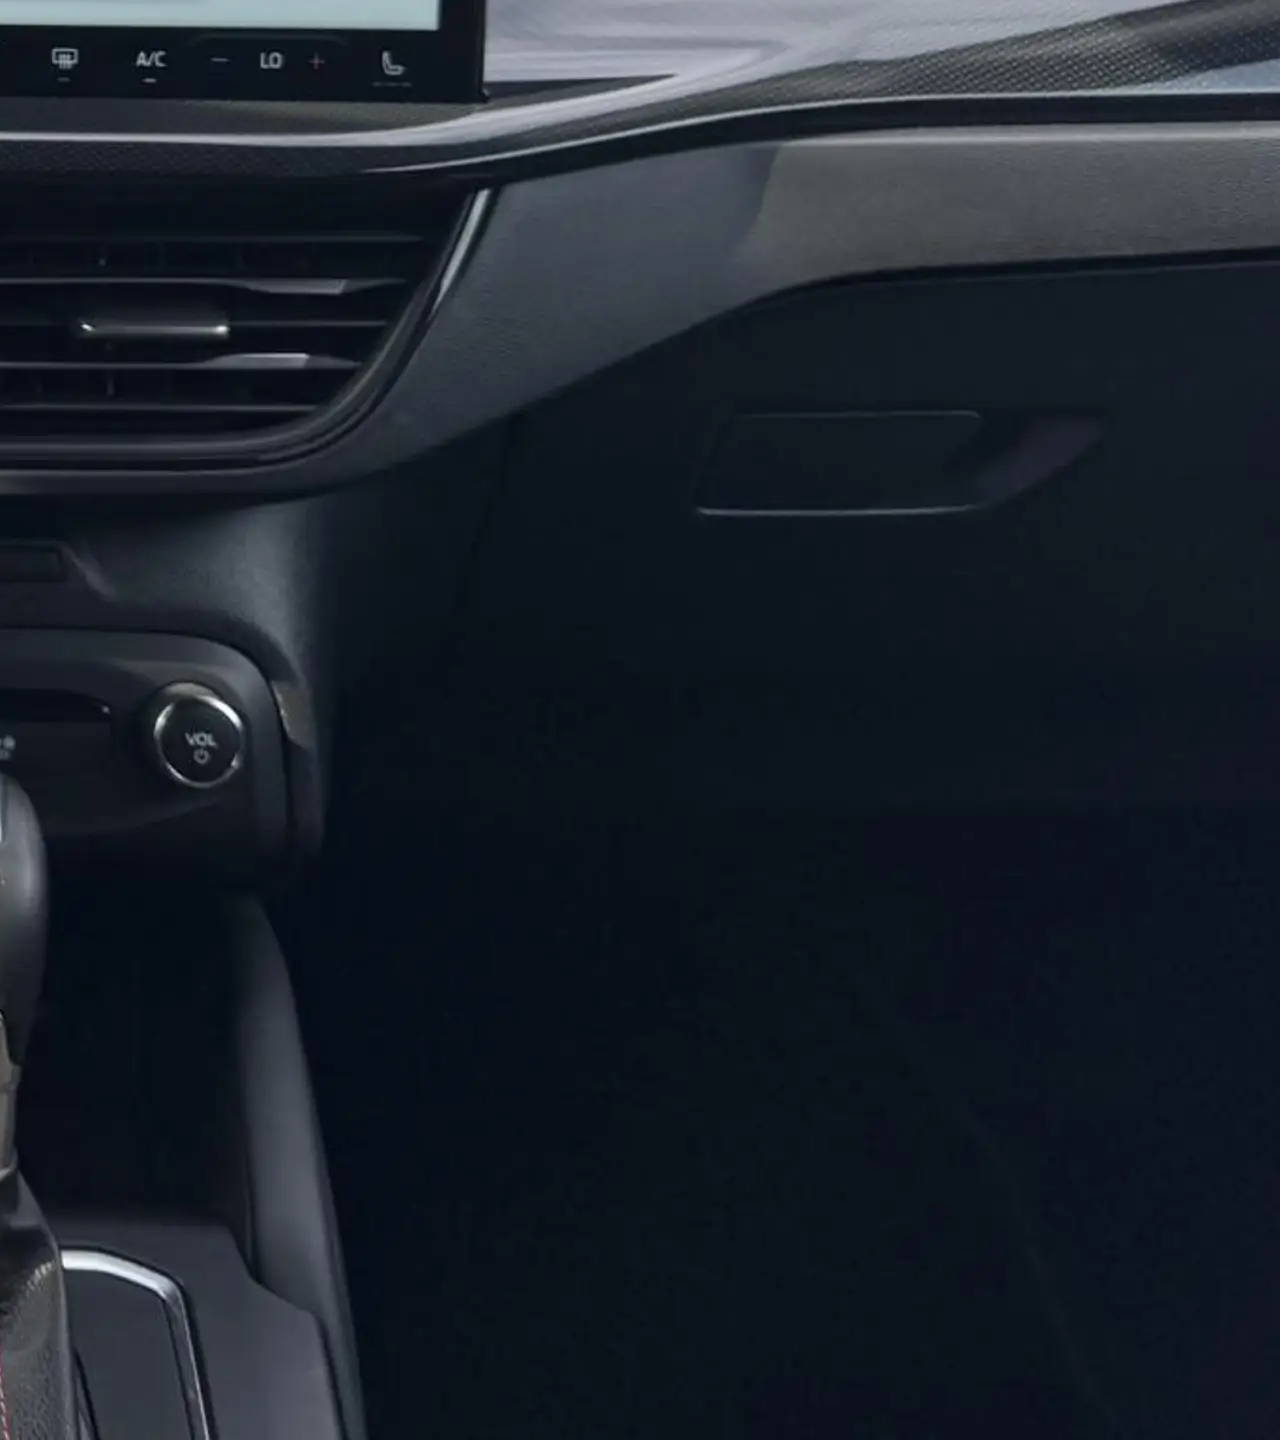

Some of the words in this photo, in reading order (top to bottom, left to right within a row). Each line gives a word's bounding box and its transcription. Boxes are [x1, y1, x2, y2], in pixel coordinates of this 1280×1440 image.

[136, 50, 167, 69] A/C
[260, 52, 283, 70] LO
[184, 731, 218, 748] VOL
